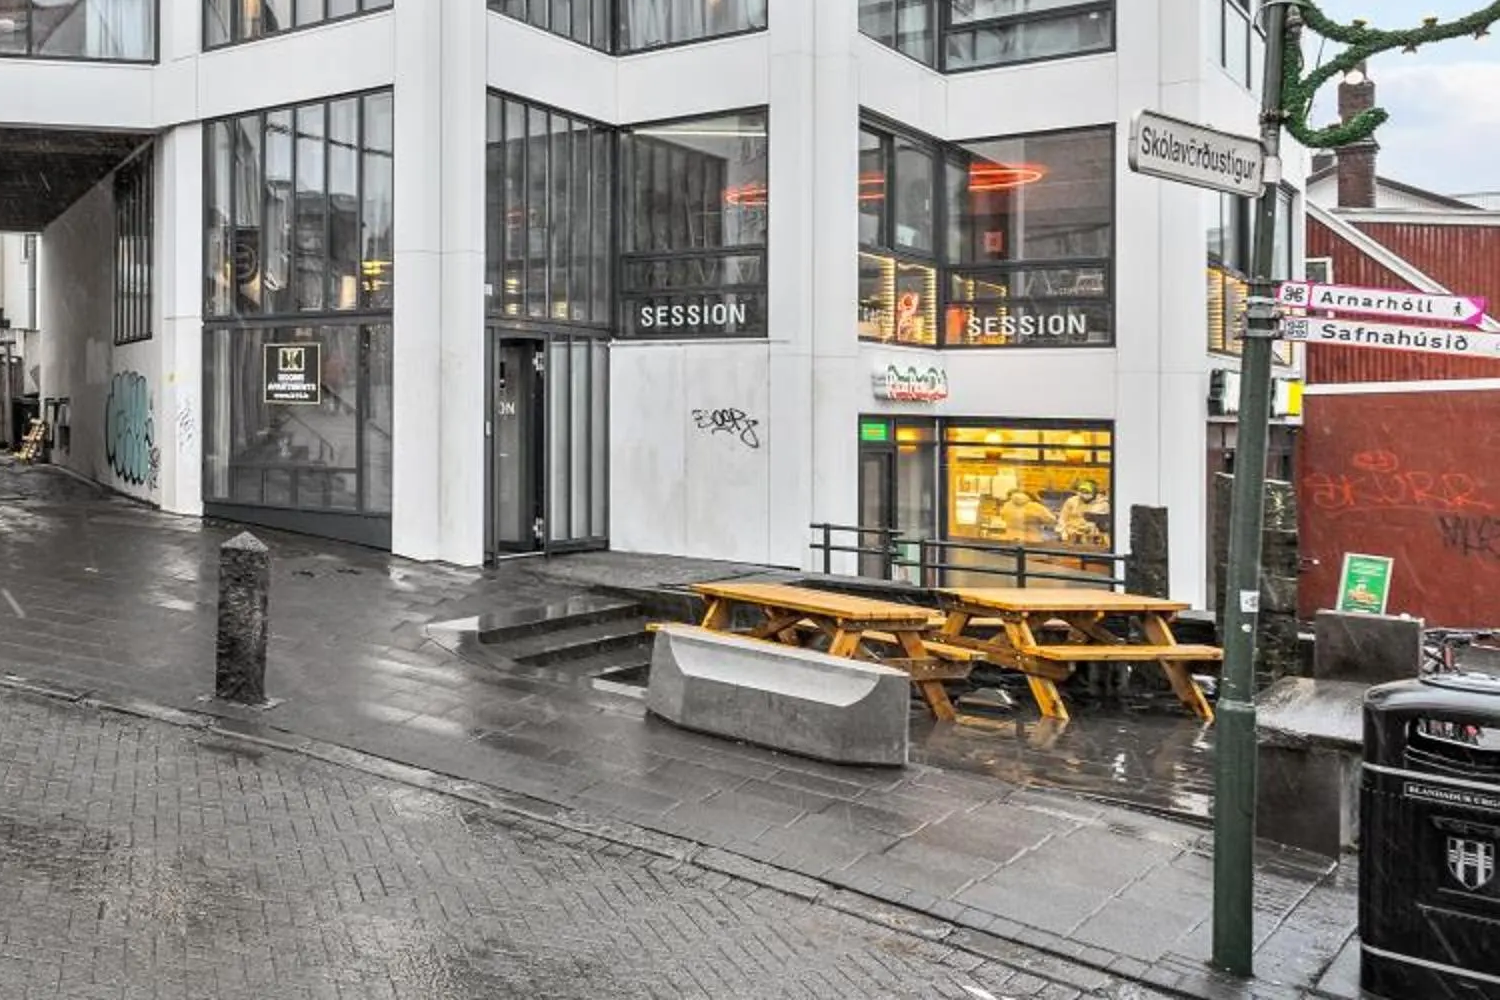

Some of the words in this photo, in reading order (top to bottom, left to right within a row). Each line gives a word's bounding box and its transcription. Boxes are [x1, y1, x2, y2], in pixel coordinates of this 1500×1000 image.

[1141, 126, 1256, 184] Skólavörðustígur
[1320, 291, 1433, 314] Arnarhóll
[641, 303, 746, 327] SESSION
[967, 314, 1087, 336] SESSION
[1321, 323, 1469, 351] Safnahúsið
